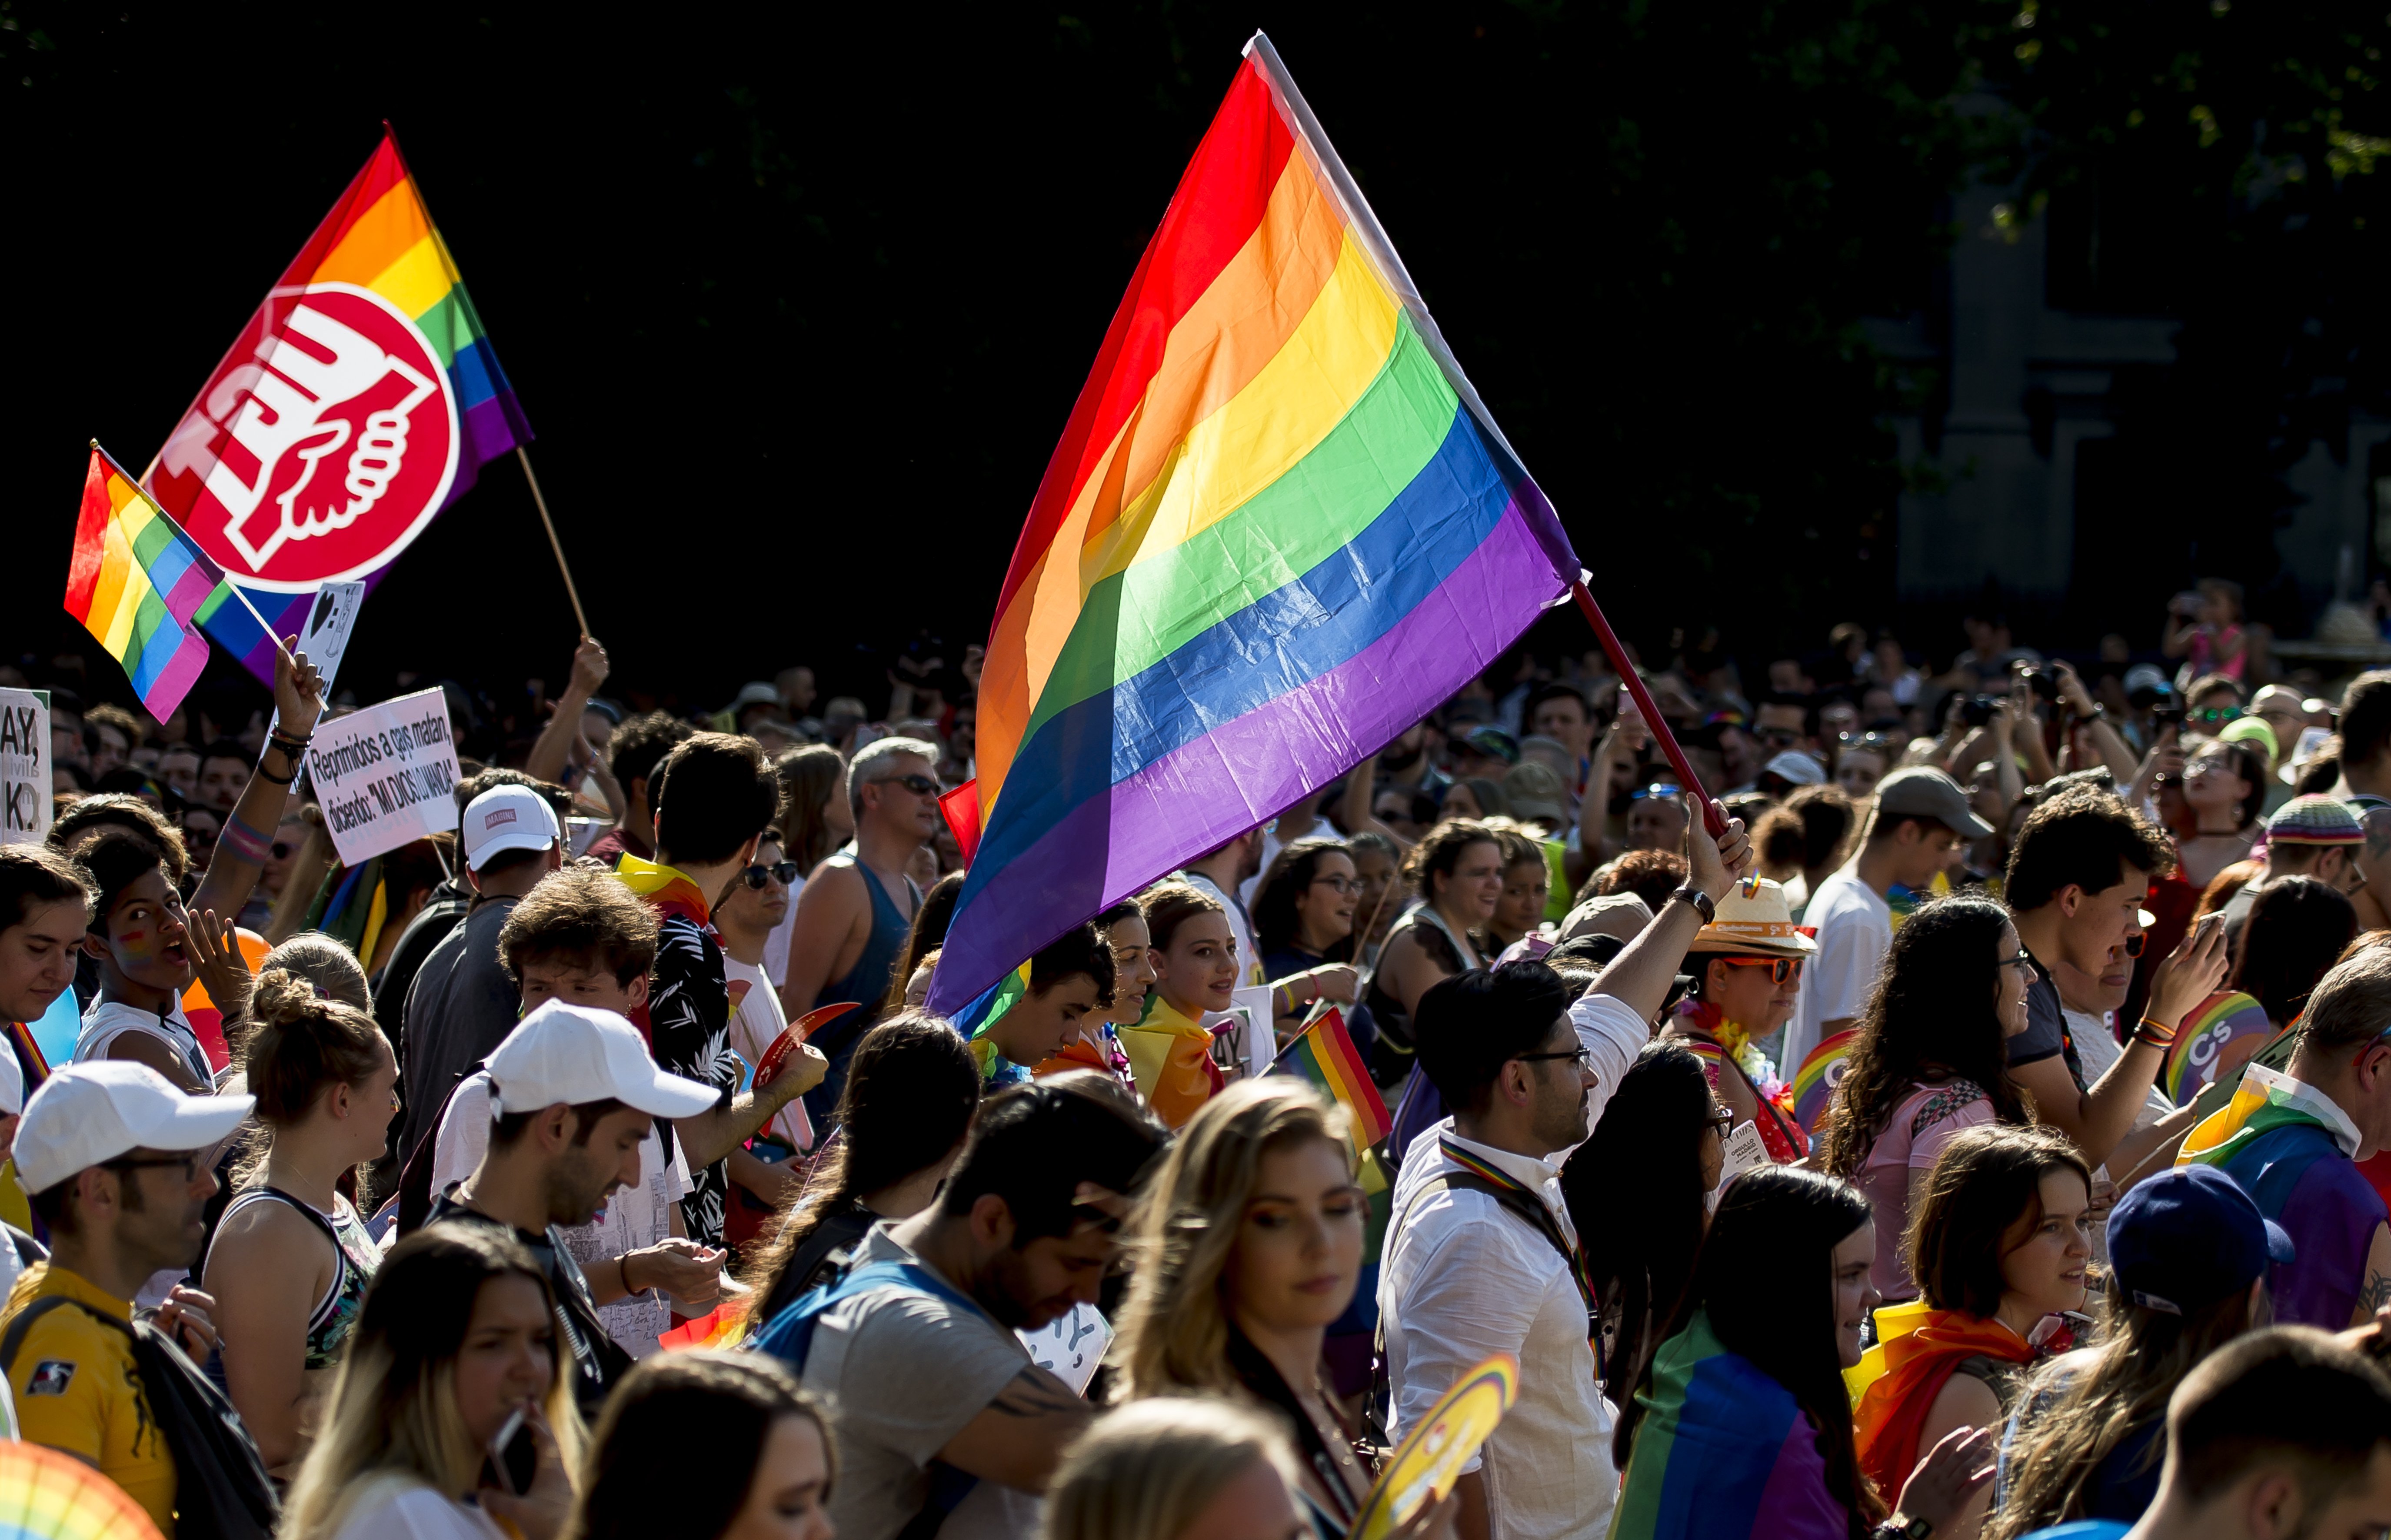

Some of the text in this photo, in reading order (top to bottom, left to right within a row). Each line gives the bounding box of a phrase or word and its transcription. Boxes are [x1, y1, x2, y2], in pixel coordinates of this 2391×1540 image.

[310, 711, 452, 787] Reprimidos a gays matan,
[328, 790, 377, 834] diciendo:
[367, 778, 396, 815] "MI
[387, 769, 421, 810] DIOS
[420, 758, 453, 798] MANDA"
[486, 811, 515, 826] IMAGINE
[2189, 1020, 2232, 1066] Cs
[1731, 1138, 1755, 1156] ORGULLO
[1736, 1142, 1757, 1158] MADRID
